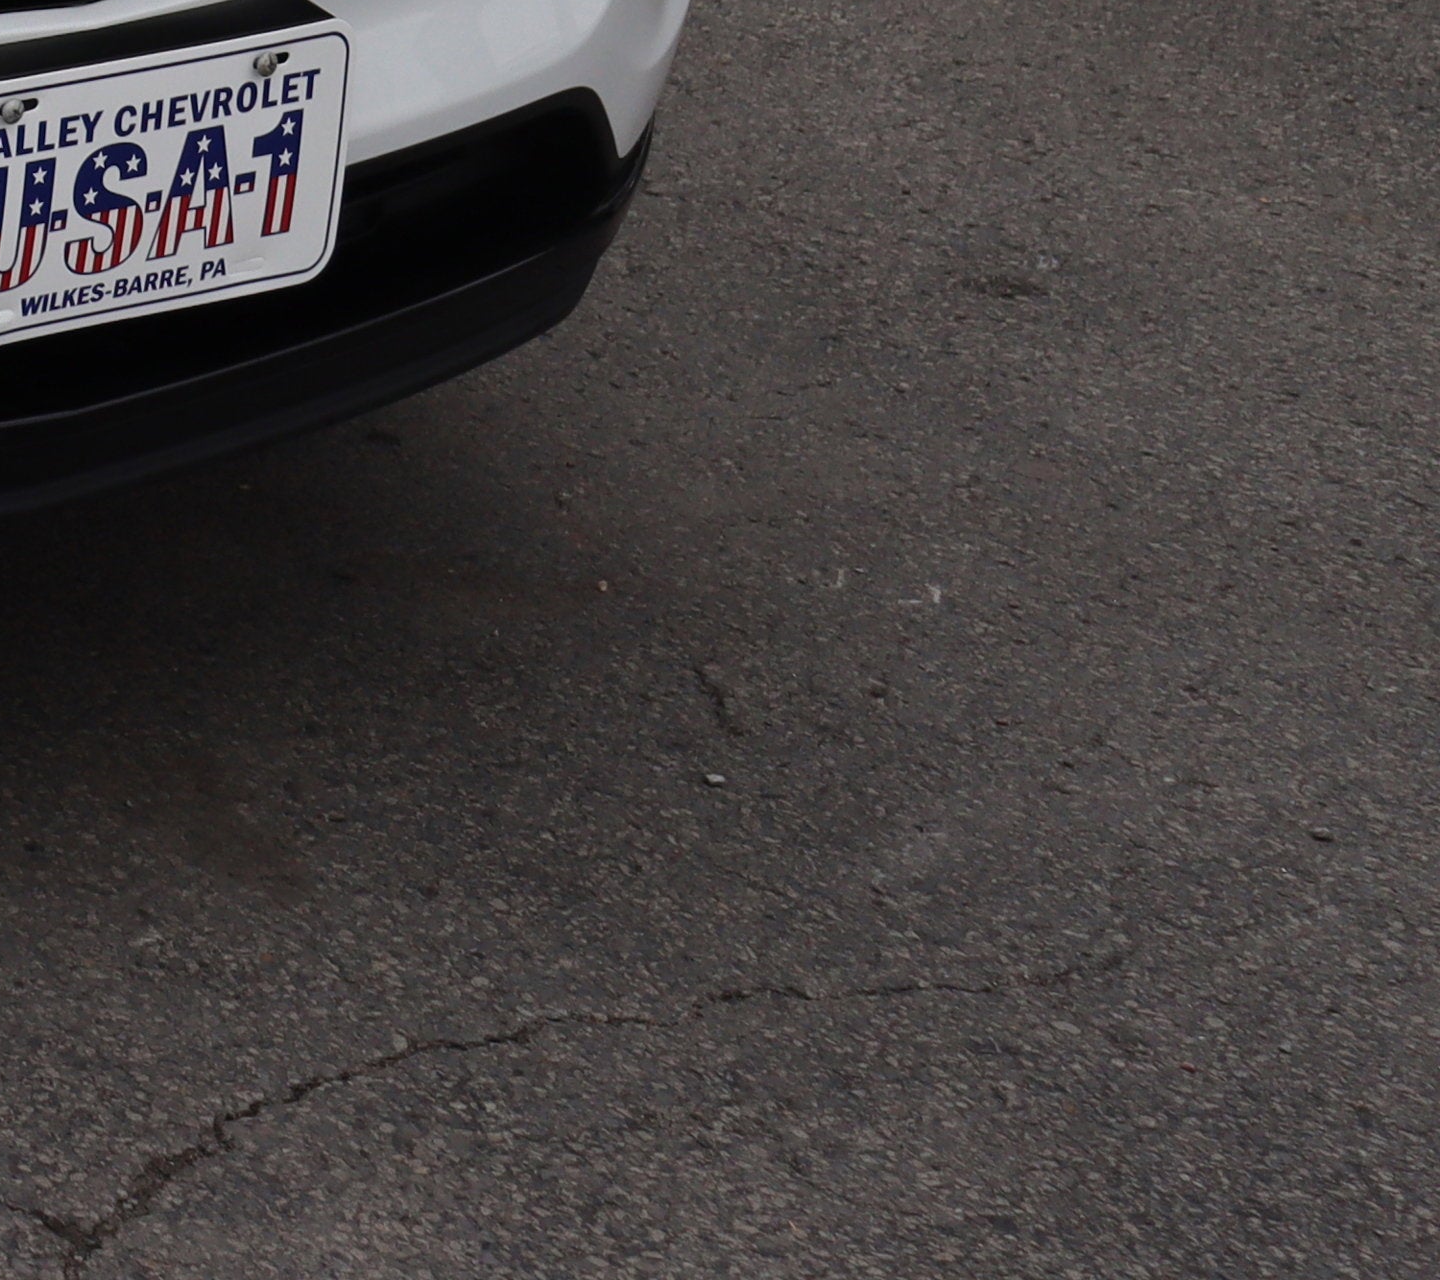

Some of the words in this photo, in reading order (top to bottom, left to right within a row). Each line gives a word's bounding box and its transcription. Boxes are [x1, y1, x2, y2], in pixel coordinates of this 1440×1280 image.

[113, 68, 321, 137] CHEVROLET
[20, 265, 193, 317] WILKES-BARRE,
[200, 260, 227, 281] PA
